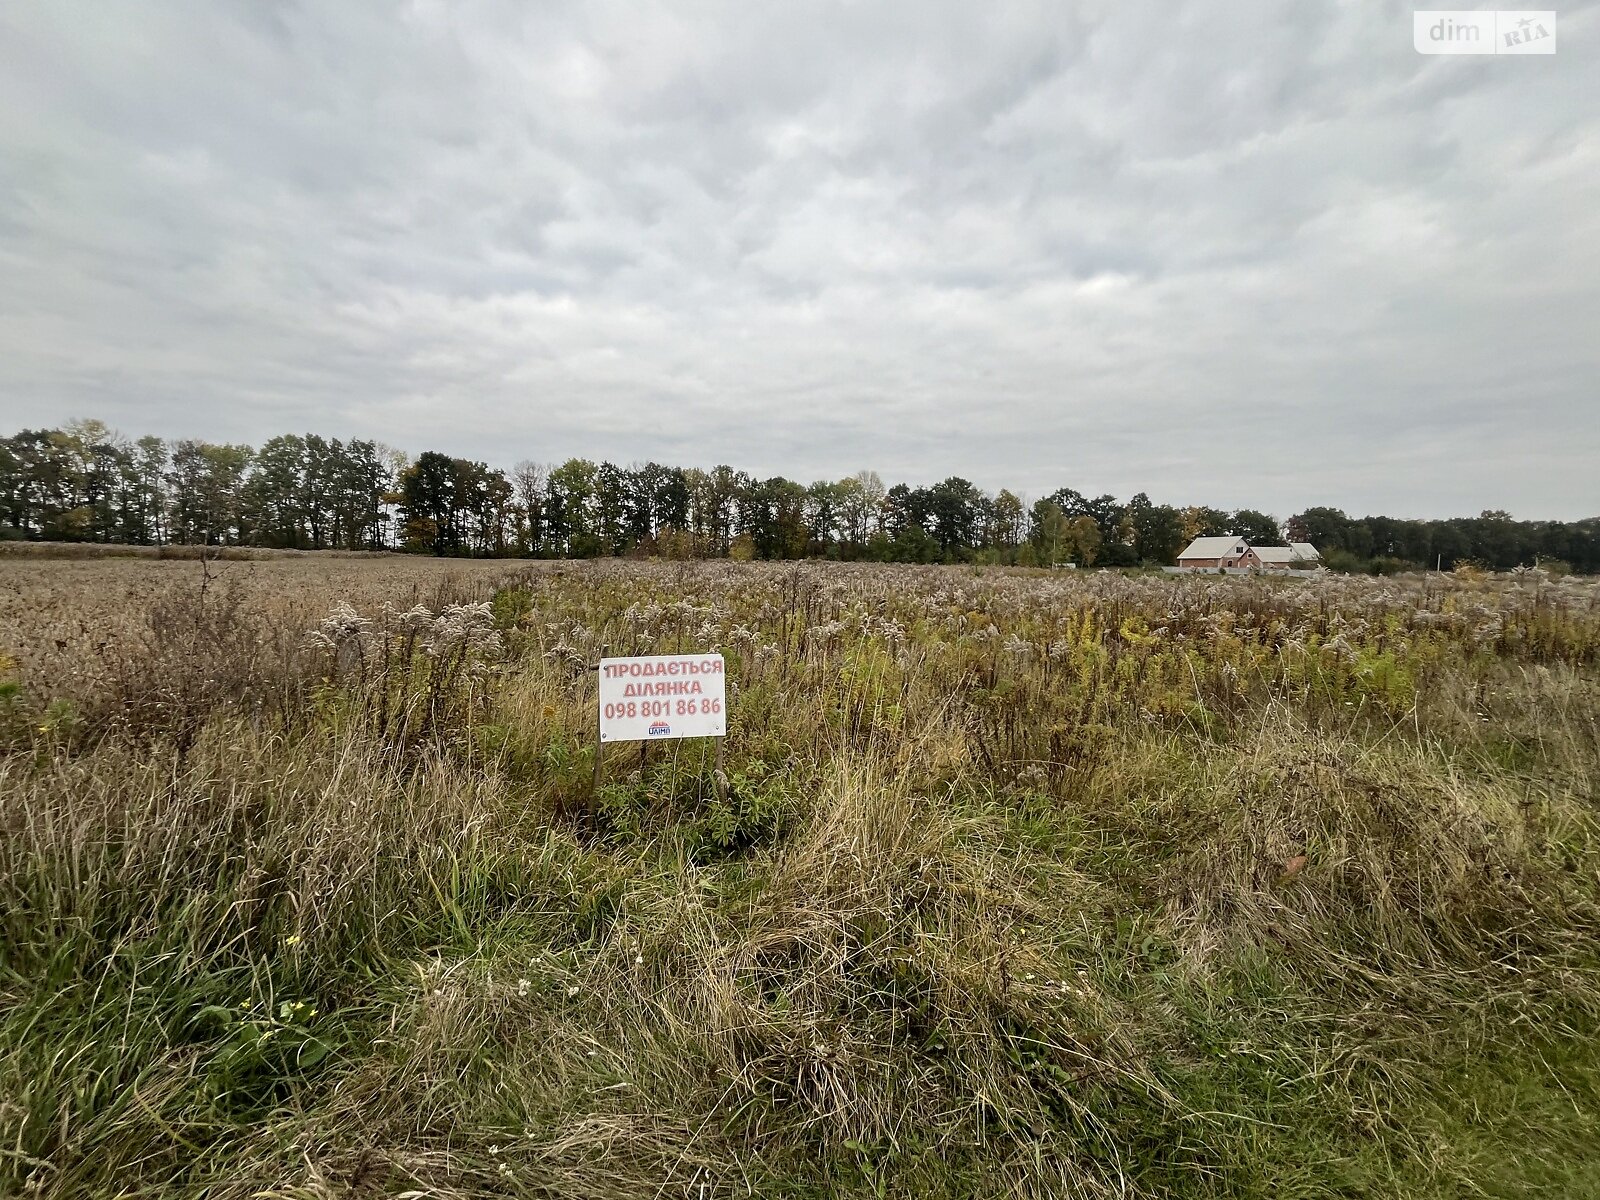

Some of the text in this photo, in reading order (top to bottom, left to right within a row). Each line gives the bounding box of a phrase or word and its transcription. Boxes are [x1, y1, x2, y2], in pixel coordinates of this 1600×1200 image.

[606, 660, 723, 678] ПРОДАЄТЬСЯ
[624, 680, 703, 697] ДІЛЯНКА
[605, 697, 721, 720] 098 801 86 86
